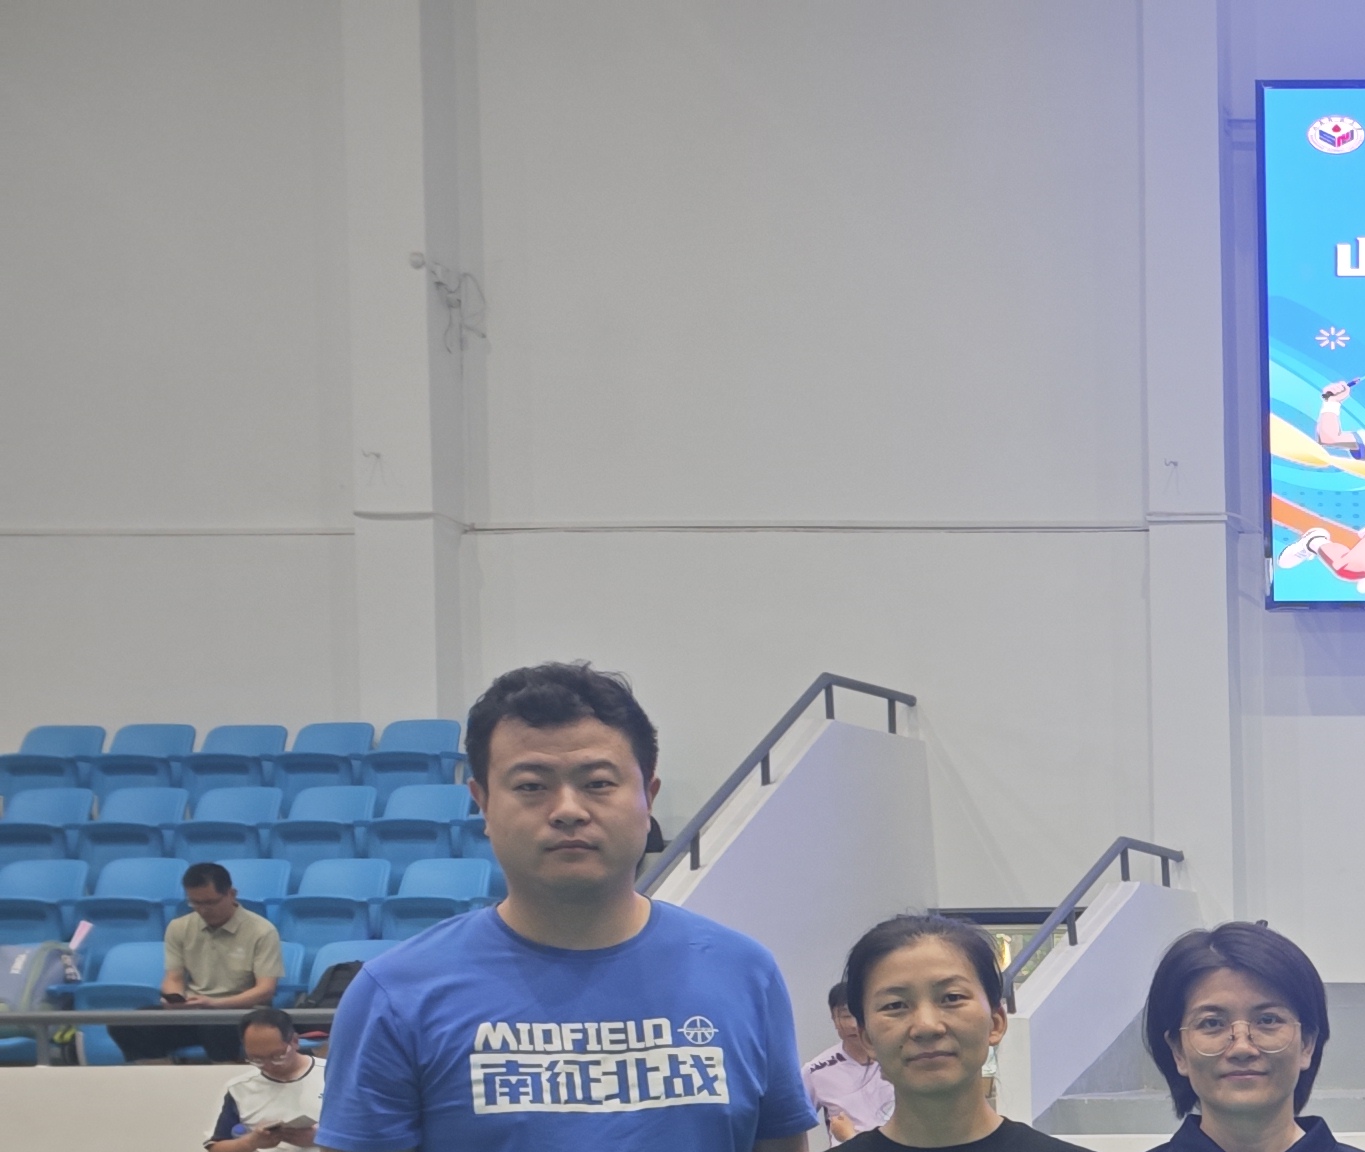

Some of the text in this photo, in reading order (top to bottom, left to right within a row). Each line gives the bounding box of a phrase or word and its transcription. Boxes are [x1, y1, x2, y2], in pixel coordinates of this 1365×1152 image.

[474, 1018, 673, 1052] MIDFIELD
[480, 1053, 721, 1107] 南征北战
